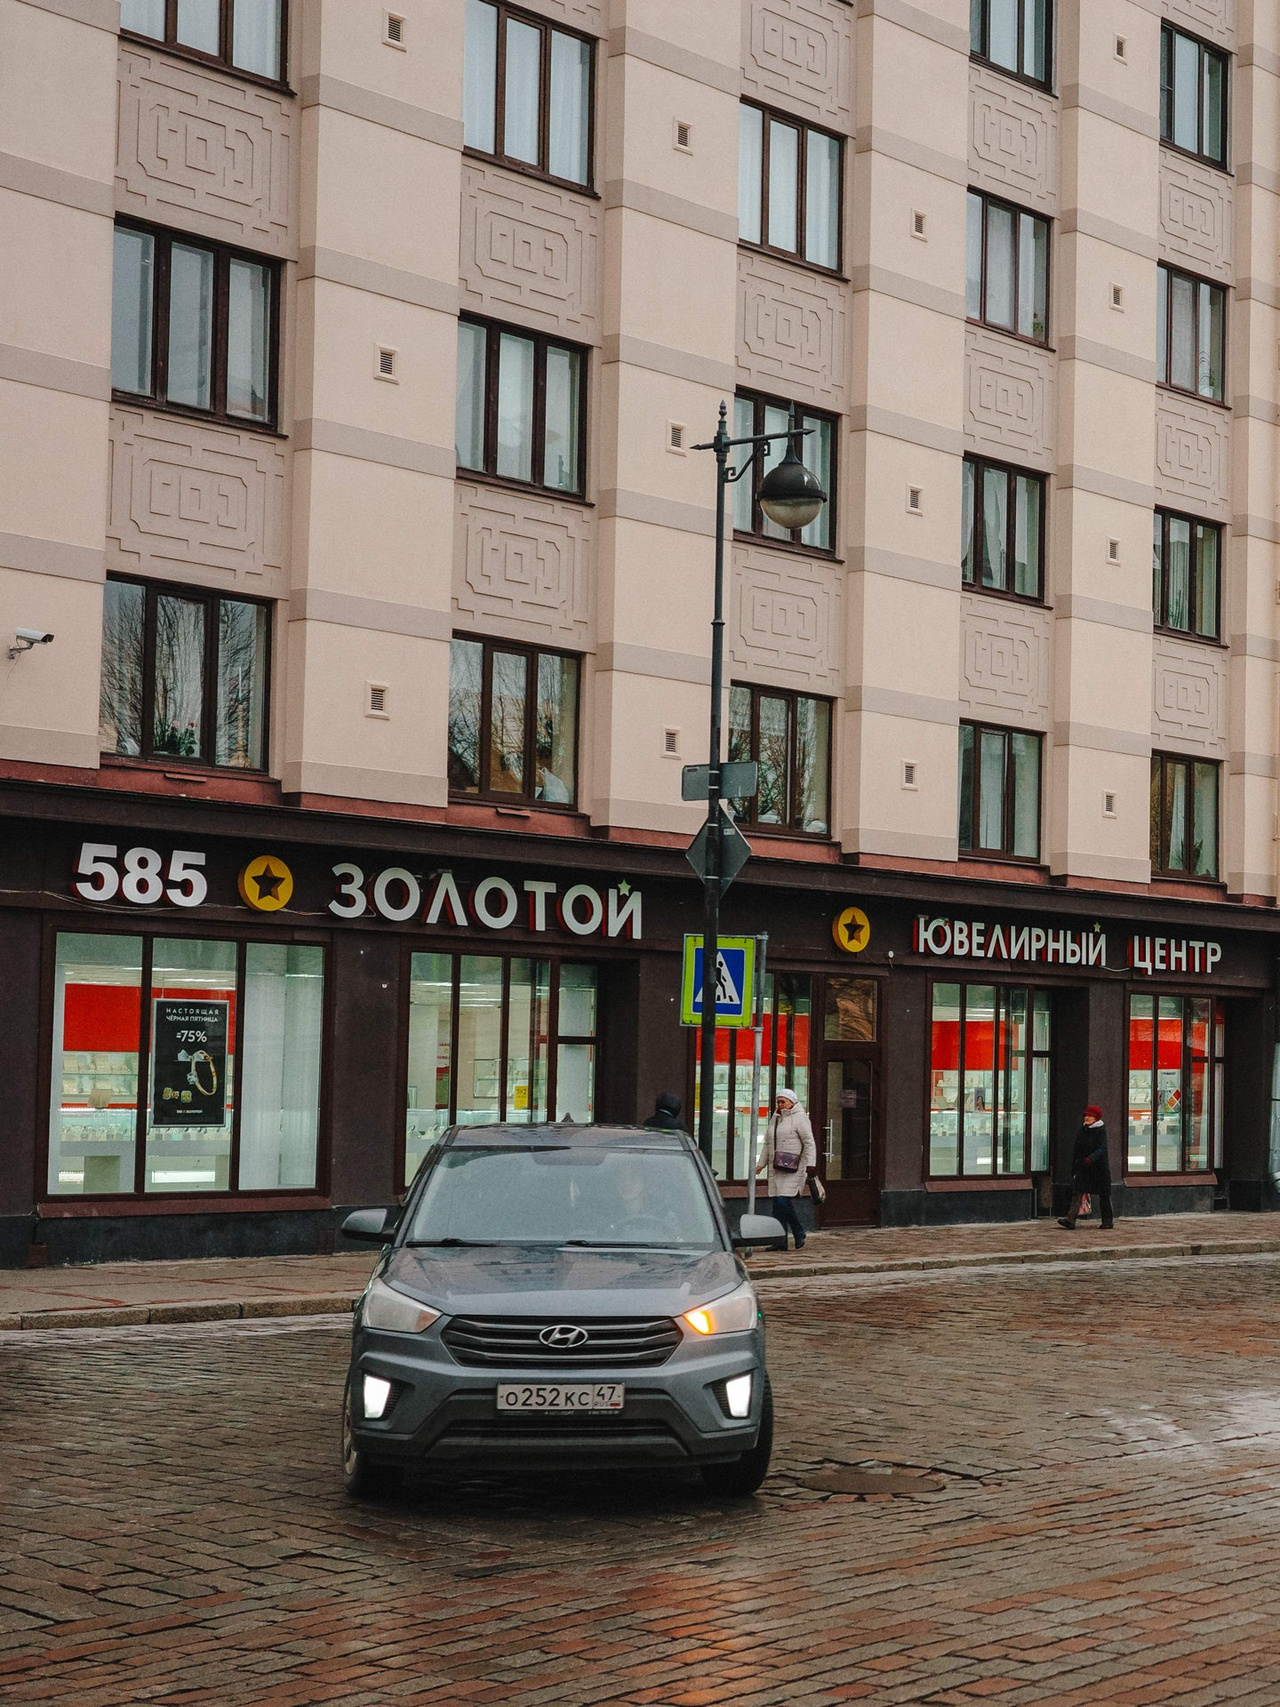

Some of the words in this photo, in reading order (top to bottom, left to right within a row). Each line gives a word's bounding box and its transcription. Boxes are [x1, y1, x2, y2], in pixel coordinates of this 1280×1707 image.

[75, 842, 208, 907] 585
[327, 862, 643, 940] ЗОЛОТОЙ
[916, 916, 1107, 967] ЮВЕЛИРНЫЙ
[1132, 934, 1222, 975] ЦЕНТР
[505, 1387, 590, 1407] О252КС
[596, 1386, 617, 1401] 47
